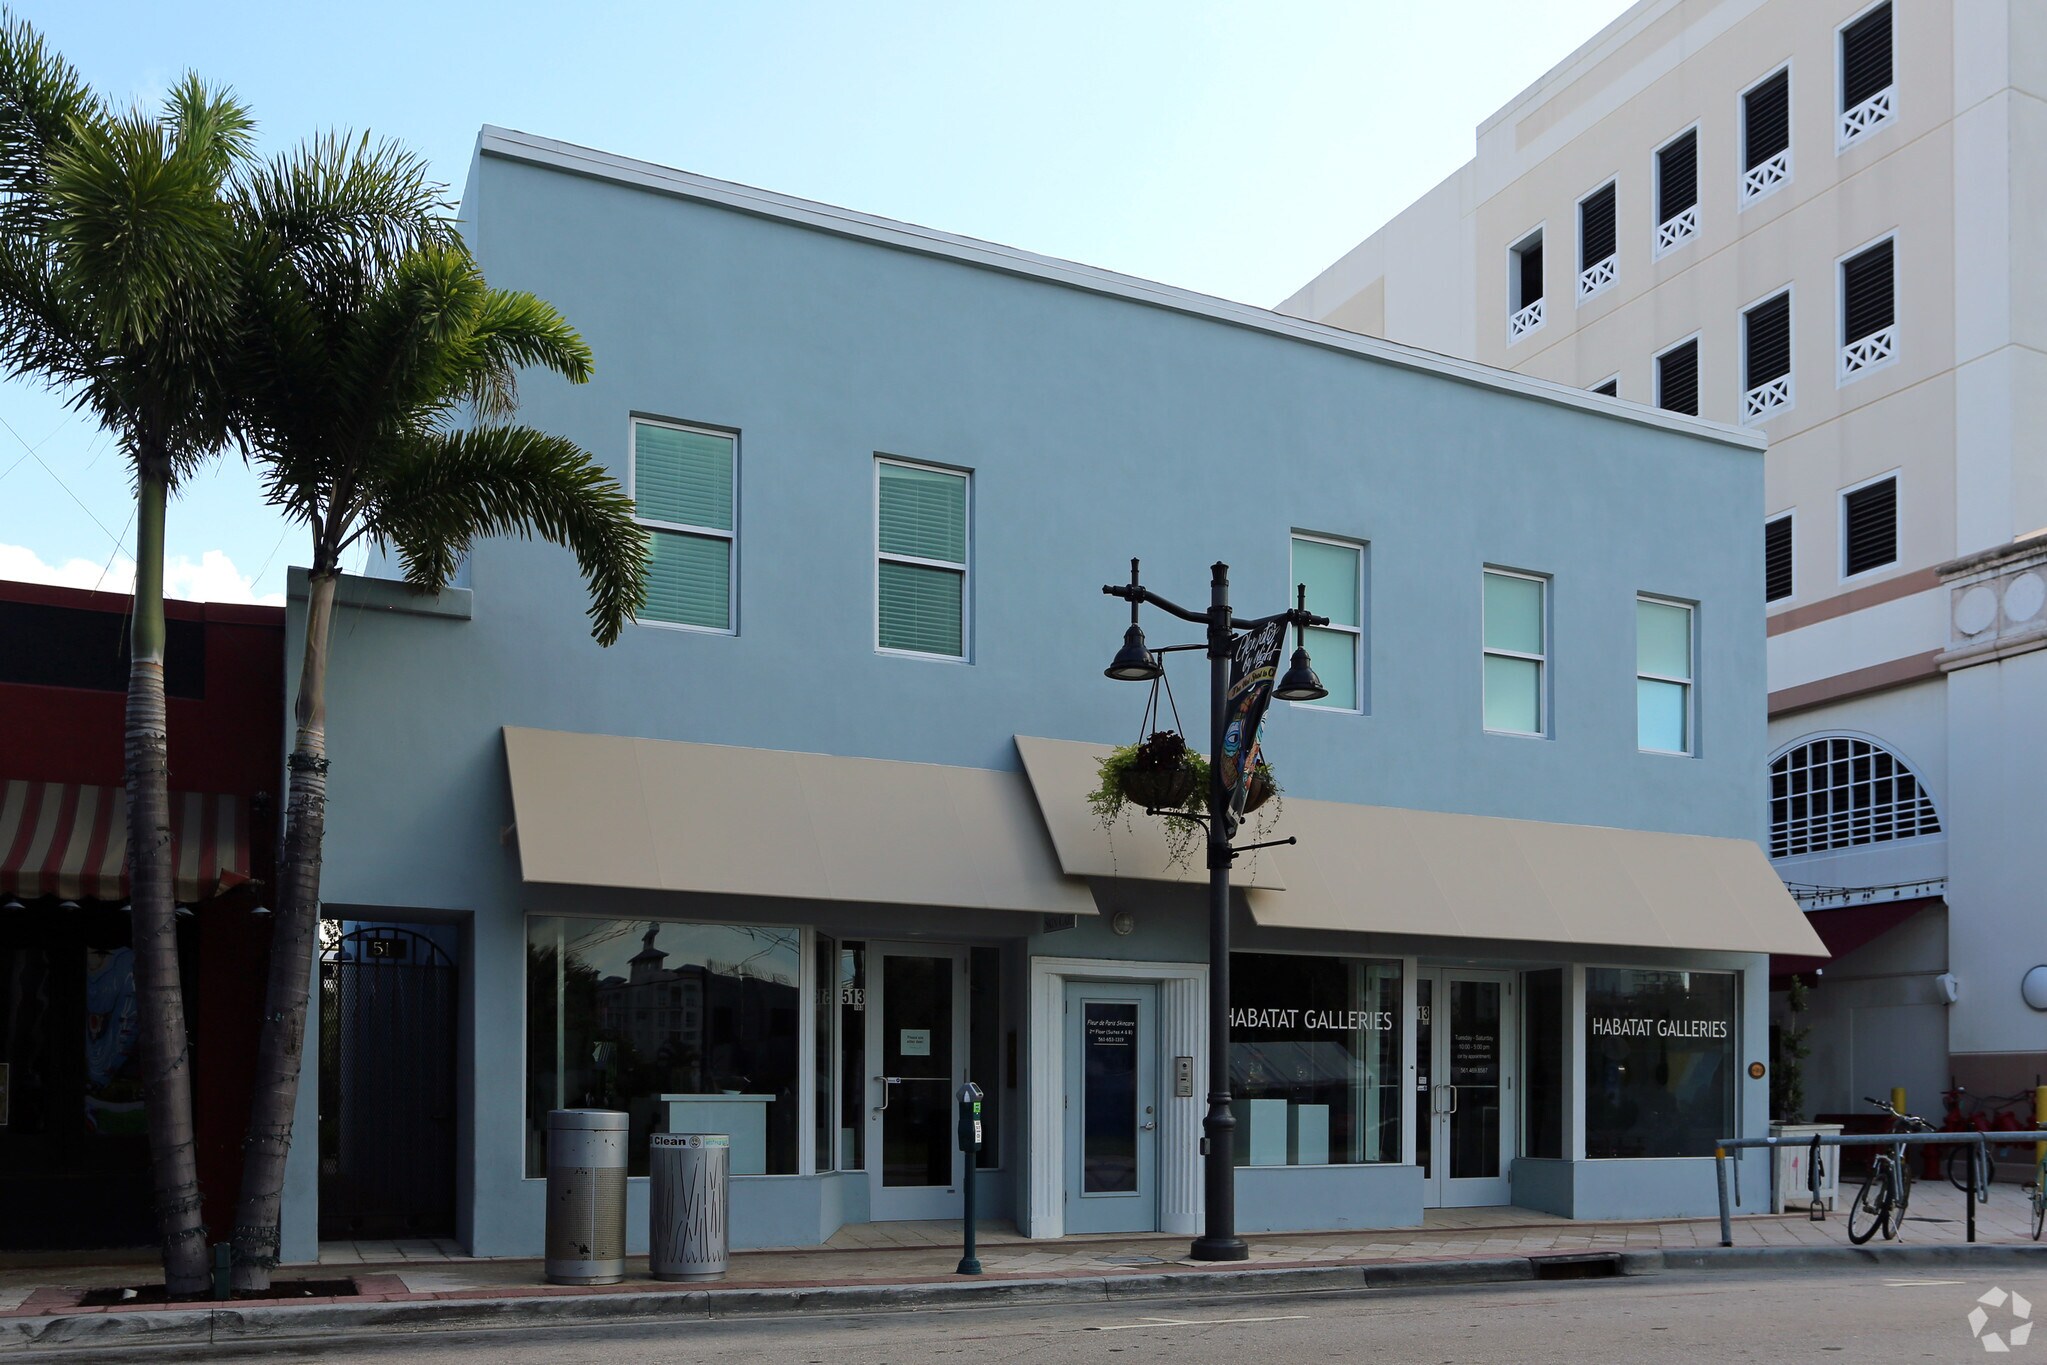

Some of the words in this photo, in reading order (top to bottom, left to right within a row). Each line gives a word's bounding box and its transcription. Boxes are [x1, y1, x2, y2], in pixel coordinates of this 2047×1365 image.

[842, 989, 864, 1004] 513
[1304, 1009, 1393, 1031] GALLERIES
[1592, 1017, 1653, 1036] HABATAT
[1657, 1019, 1727, 1038] GALLERIES
[654, 1136, 686, 1146] Clean
